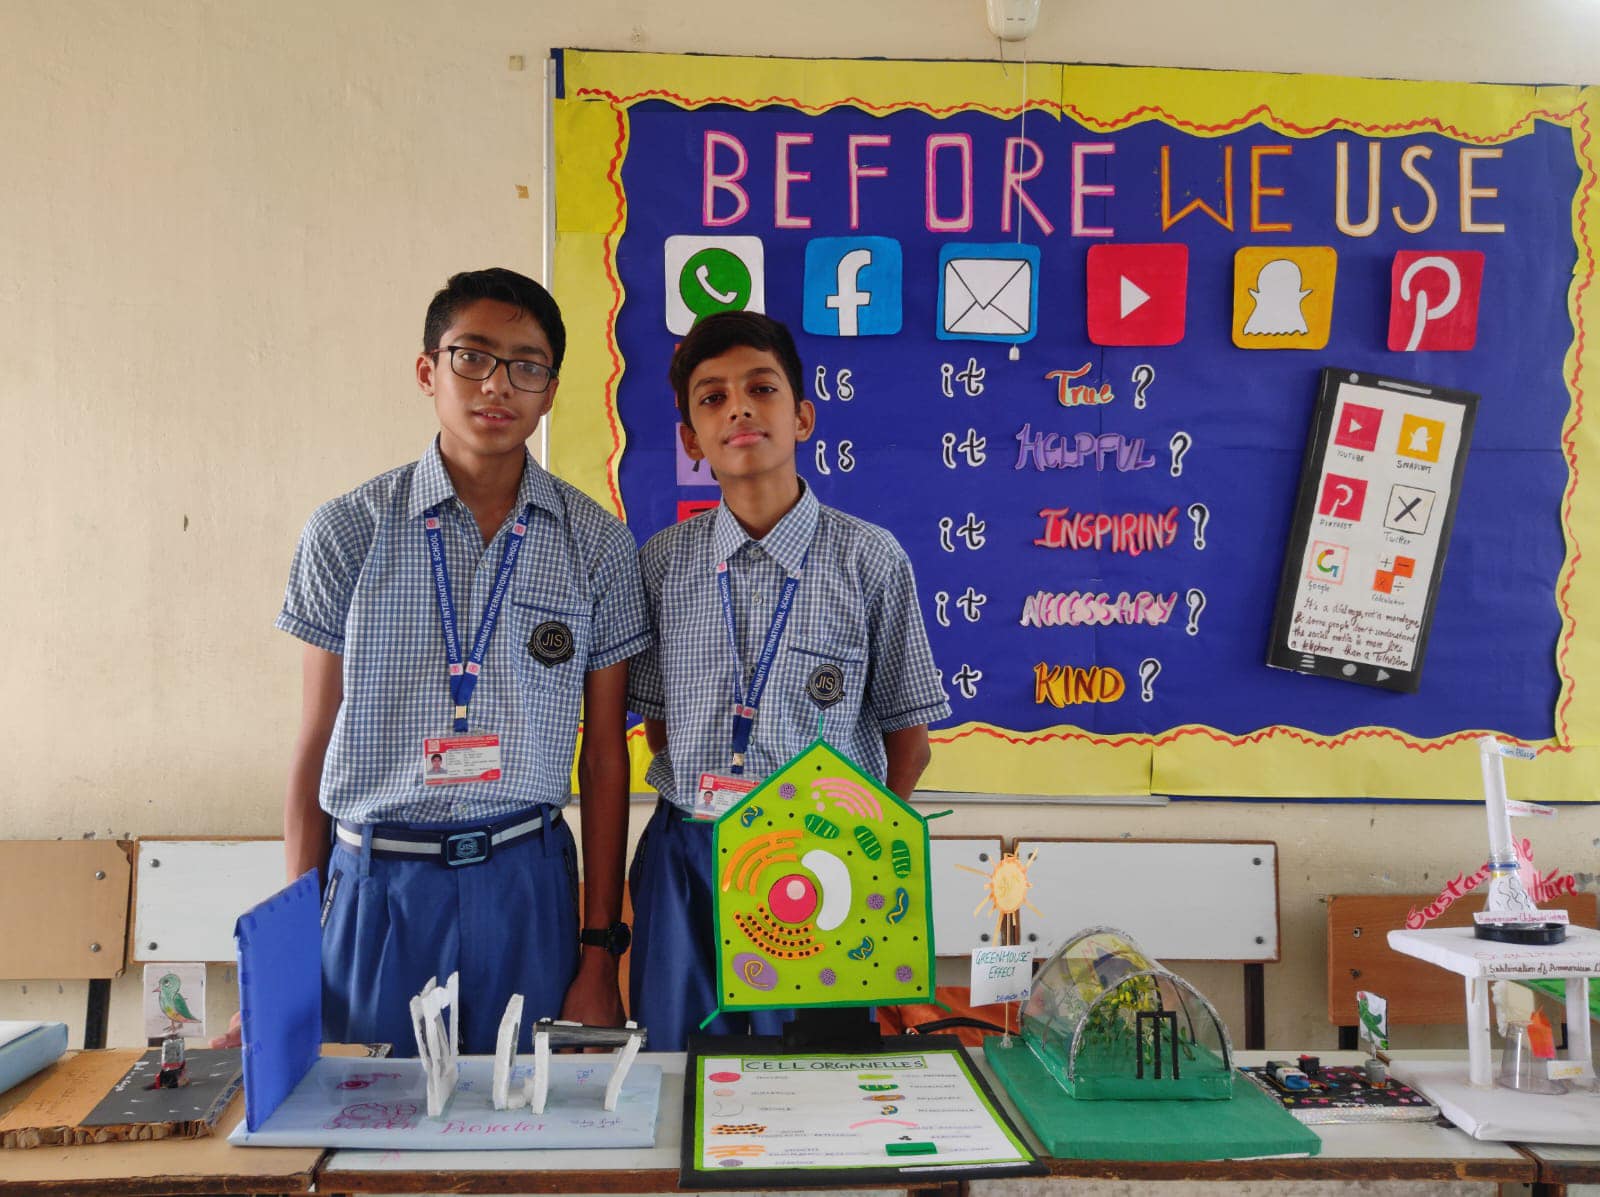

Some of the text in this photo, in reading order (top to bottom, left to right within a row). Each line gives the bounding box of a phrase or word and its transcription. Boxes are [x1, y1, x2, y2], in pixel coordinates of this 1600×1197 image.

[702, 130, 1506, 237] BEFORE WE USE
[815, 357, 1155, 410] is it True ?
[815, 423, 1192, 477] is it HELPFUL ?
[430, 532, 442, 562] SCHOOL
[939, 512, 986, 552] it
[1033, 505, 1179, 556] INSPIRING
[435, 564, 451, 618] INTERNATIONAL
[488, 567, 510, 621] INTERNATIONAL
[505, 539, 520, 569] SCHOOL
[762, 610, 785, 664] INTERNATIONAL
[782, 583, 795, 609] SCHOOL
[935, 587, 1206, 636] it NECESSARY ?
[542, 632, 563, 647] JIS
[816, 675, 834, 690] JIS
[1033, 662, 1126, 709] KIND
[1139, 658, 1161, 702] ?
[989, 966, 1015, 979] EFFECT
[745, 1060, 923, 1070] CELL ORGANELLES
